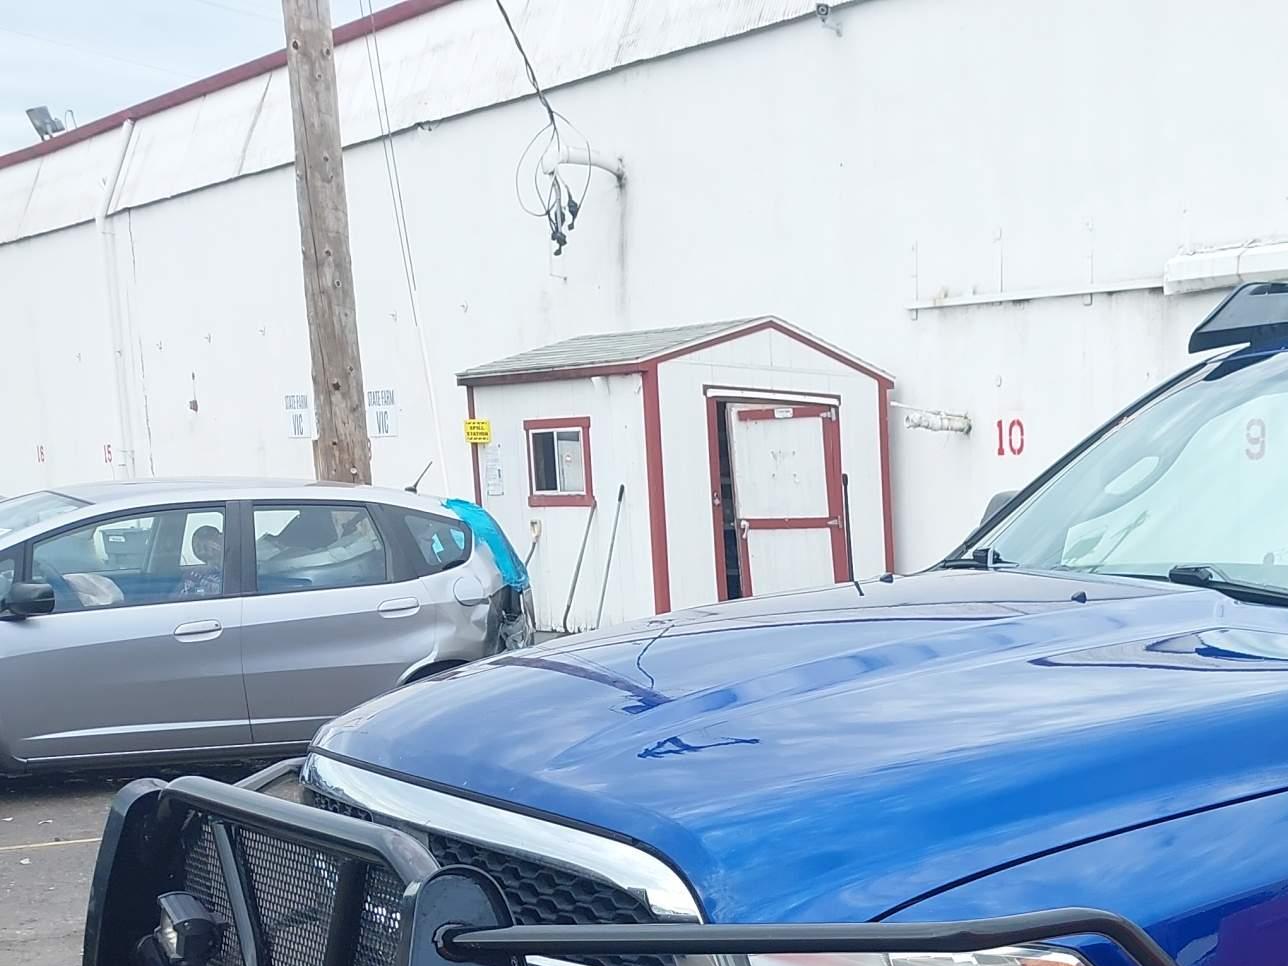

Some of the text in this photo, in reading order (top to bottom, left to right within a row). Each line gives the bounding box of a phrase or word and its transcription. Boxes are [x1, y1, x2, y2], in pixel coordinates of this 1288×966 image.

[367, 390, 395, 407] STATE FARM
[292, 414, 304, 436] VIC
[376, 411, 389, 435] VIC
[996, 418, 1025, 456] 10
[1245, 418, 1267, 460] 9
[103, 444, 113, 463] 15
